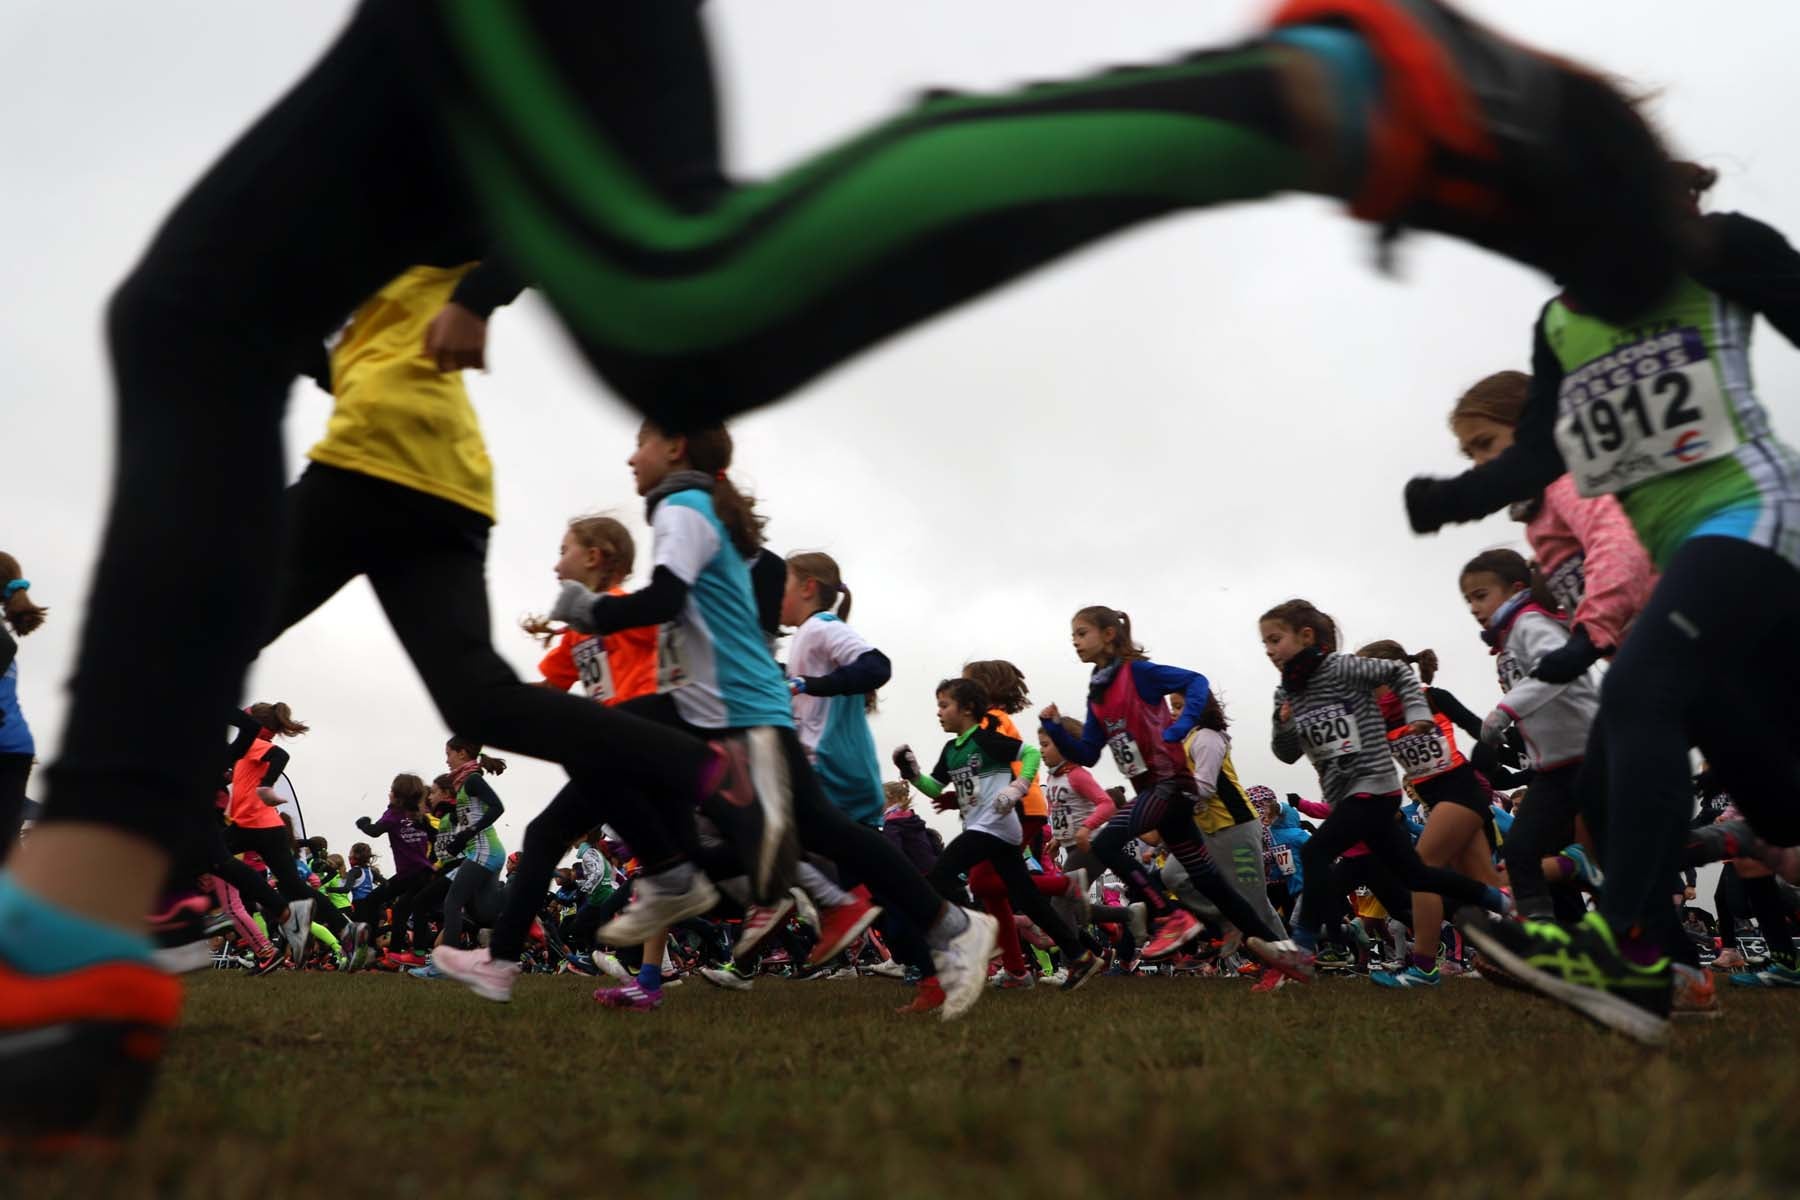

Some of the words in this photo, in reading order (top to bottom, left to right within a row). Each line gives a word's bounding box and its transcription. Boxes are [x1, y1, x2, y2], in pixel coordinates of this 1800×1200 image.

[1569, 371, 1703, 460] 1912
[1302, 717, 1349, 748] 1620
[1400, 740, 1443, 768] 1959
